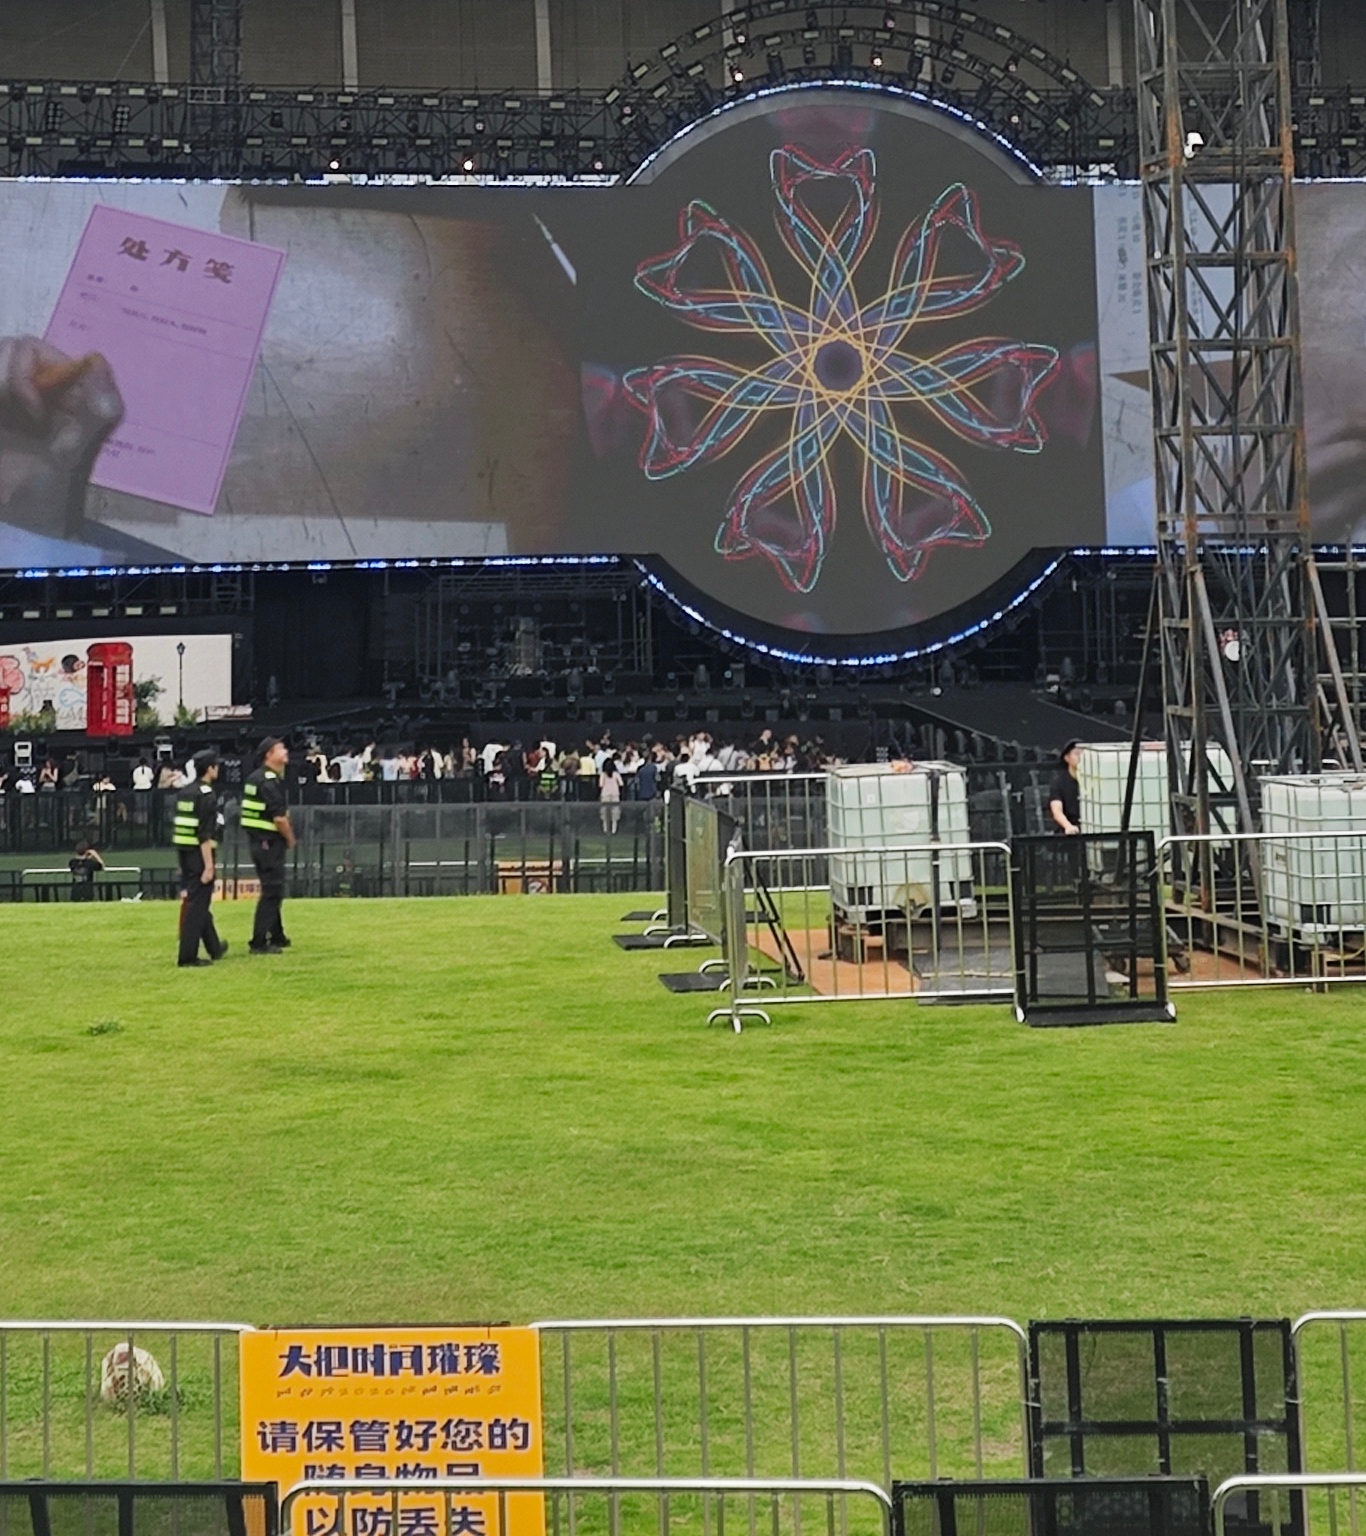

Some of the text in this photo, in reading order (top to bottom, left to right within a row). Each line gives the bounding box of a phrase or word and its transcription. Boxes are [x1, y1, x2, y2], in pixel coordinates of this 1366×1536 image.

[116, 236, 235, 285] 处方笺
[278, 1342, 501, 1378] 大把时间璀璨
[256, 1417, 531, 1453] 请保管好您的
